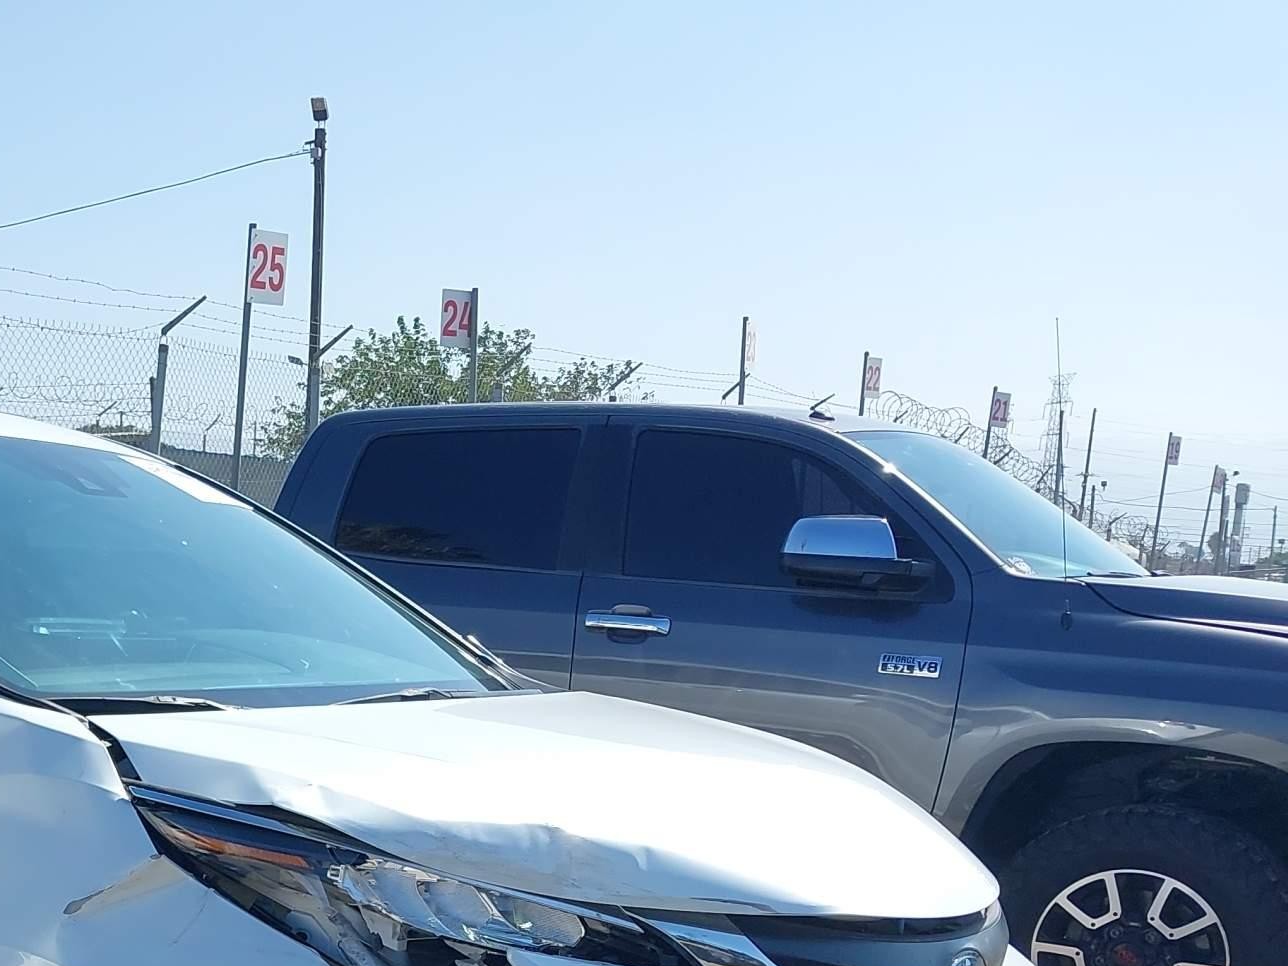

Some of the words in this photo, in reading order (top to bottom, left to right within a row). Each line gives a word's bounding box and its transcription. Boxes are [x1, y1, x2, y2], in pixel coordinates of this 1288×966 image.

[250, 244, 285, 292] 25
[443, 300, 471, 338] 24
[866, 366, 880, 391] 22
[992, 399, 1008, 422] 21
[917, 660, 938, 674] V8
